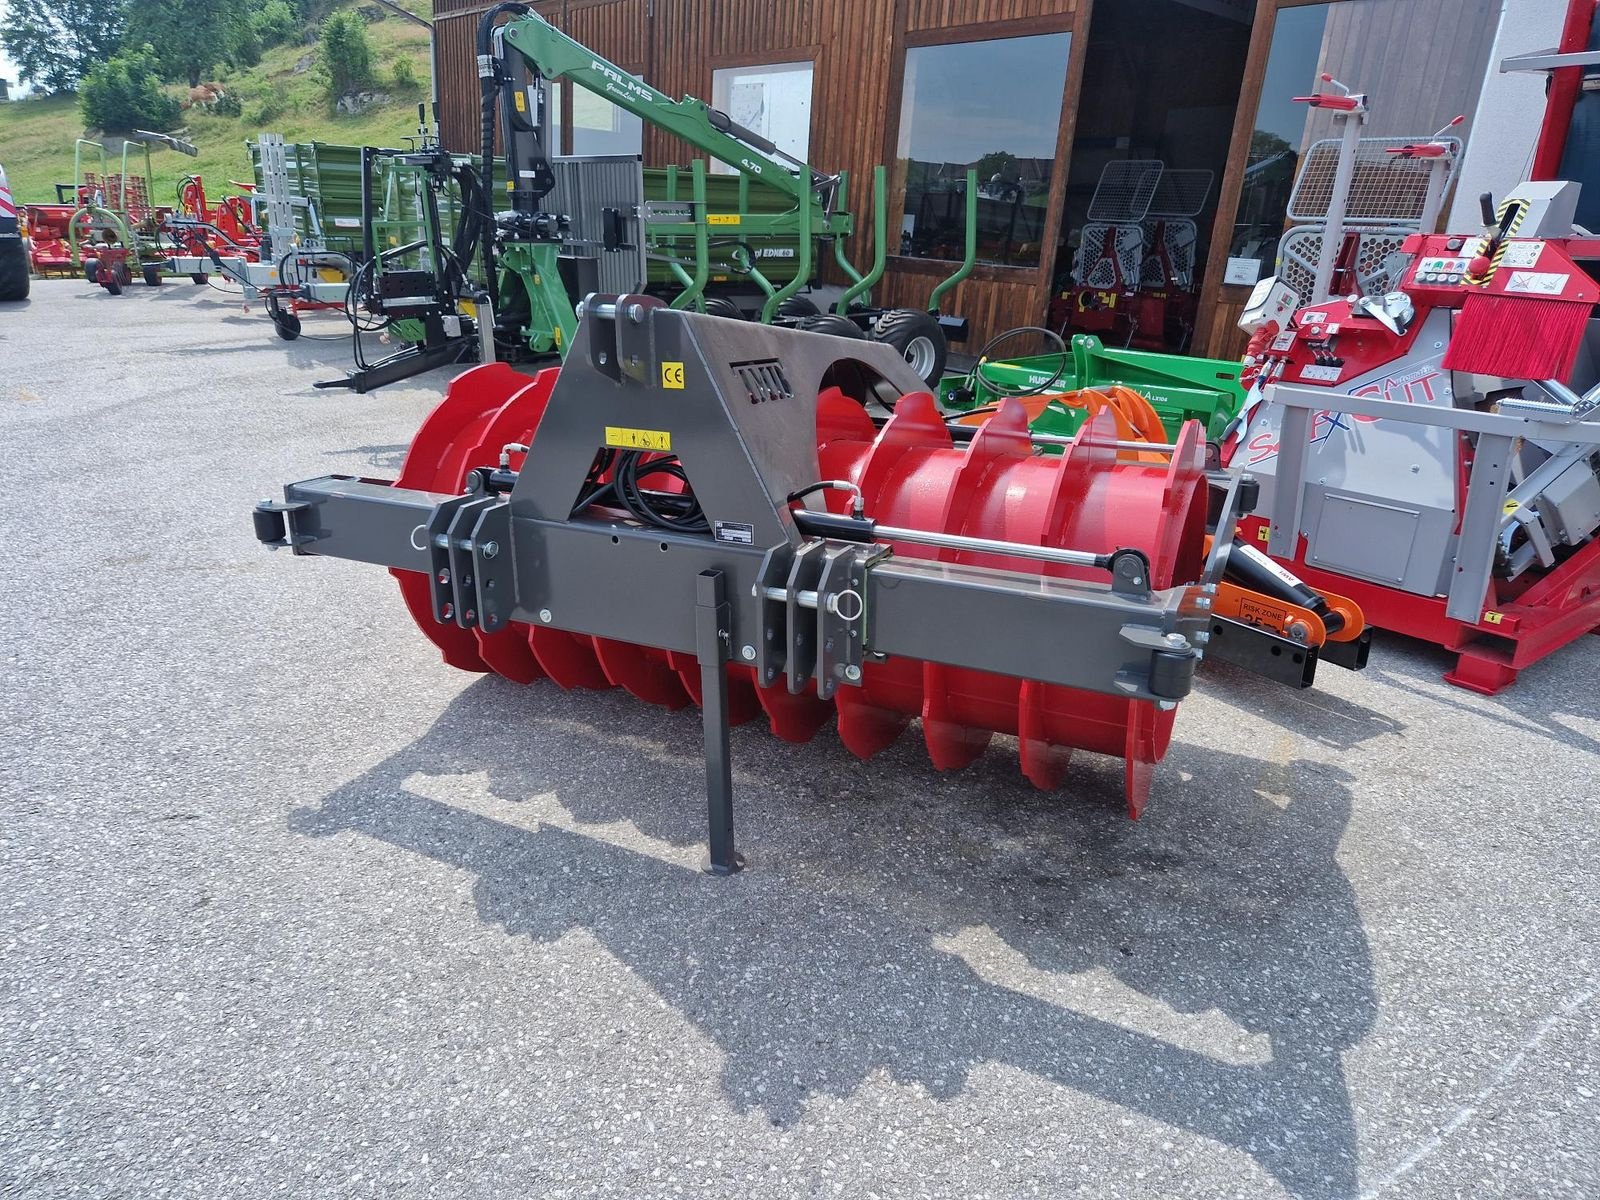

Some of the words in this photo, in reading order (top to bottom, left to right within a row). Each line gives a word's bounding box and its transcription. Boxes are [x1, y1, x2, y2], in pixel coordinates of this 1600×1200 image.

[591, 59, 653, 102] PALMS
[741, 158, 762, 175] 4.70
[664, 367, 682, 383] CE
[1242, 603, 1261, 615] RISK
[1261, 607, 1283, 621] ZONE
